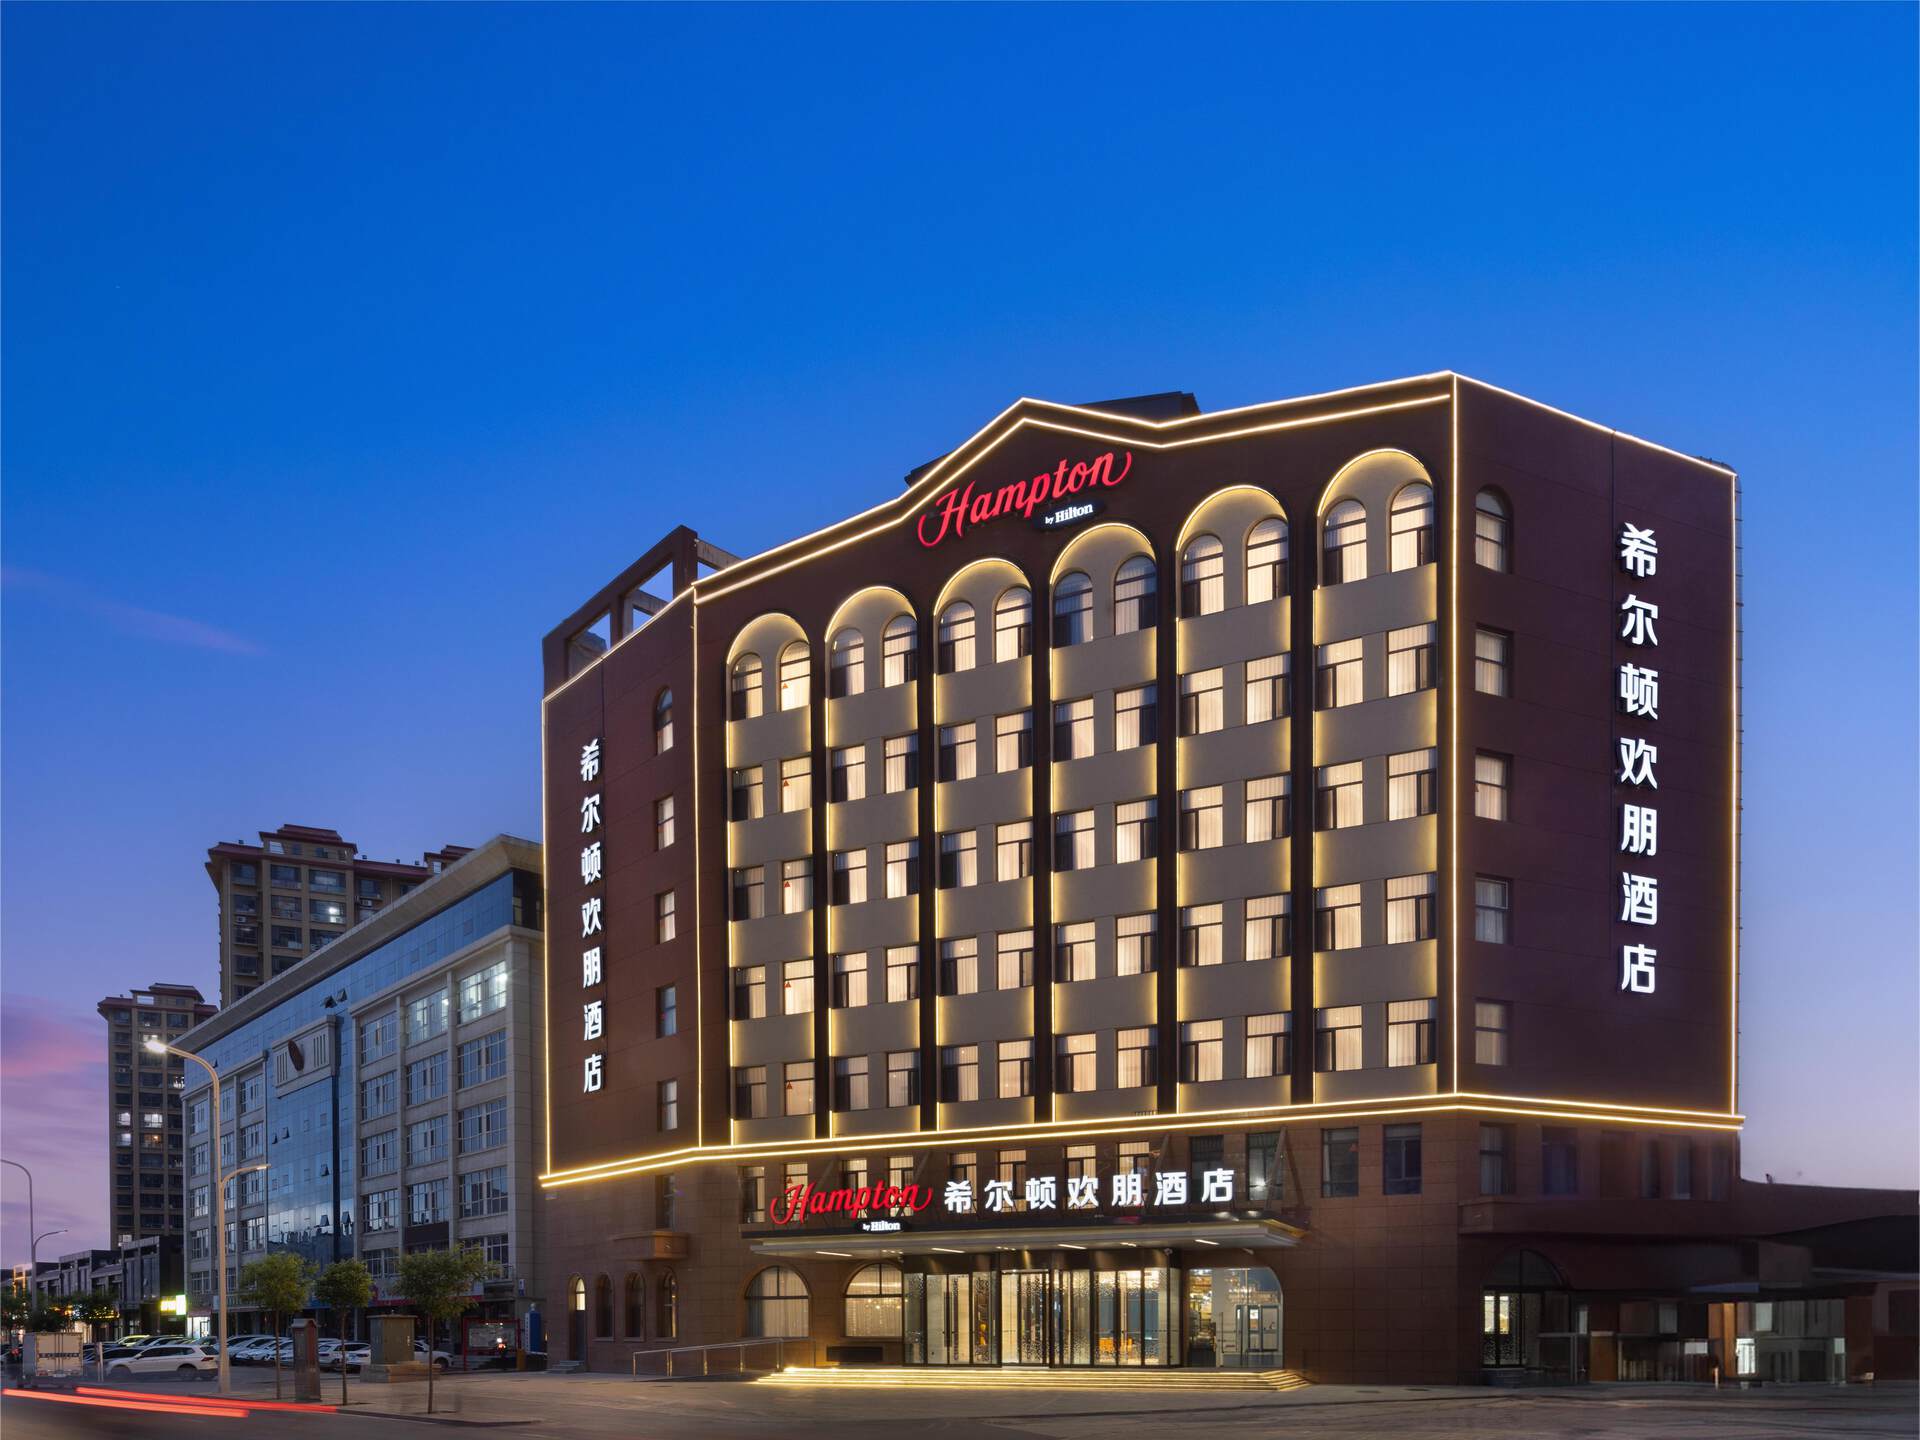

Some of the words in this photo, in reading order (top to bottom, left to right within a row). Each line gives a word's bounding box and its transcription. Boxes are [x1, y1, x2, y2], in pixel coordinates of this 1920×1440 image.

[917, 451, 1132, 547] Hampton
[1045, 515, 1054, 525] by
[1055, 503, 1093, 524] Hilton
[1620, 522, 1659, 994] 希尔顿欢朋酒店
[580, 738, 603, 1093] 希尔顿欢朋酒店
[770, 1179, 932, 1225] Hampton
[944, 1168, 1235, 1213] 希尔顿欢朋酒店
[862, 1223, 870, 1232] by
[871, 1221, 901, 1232] Hilton
